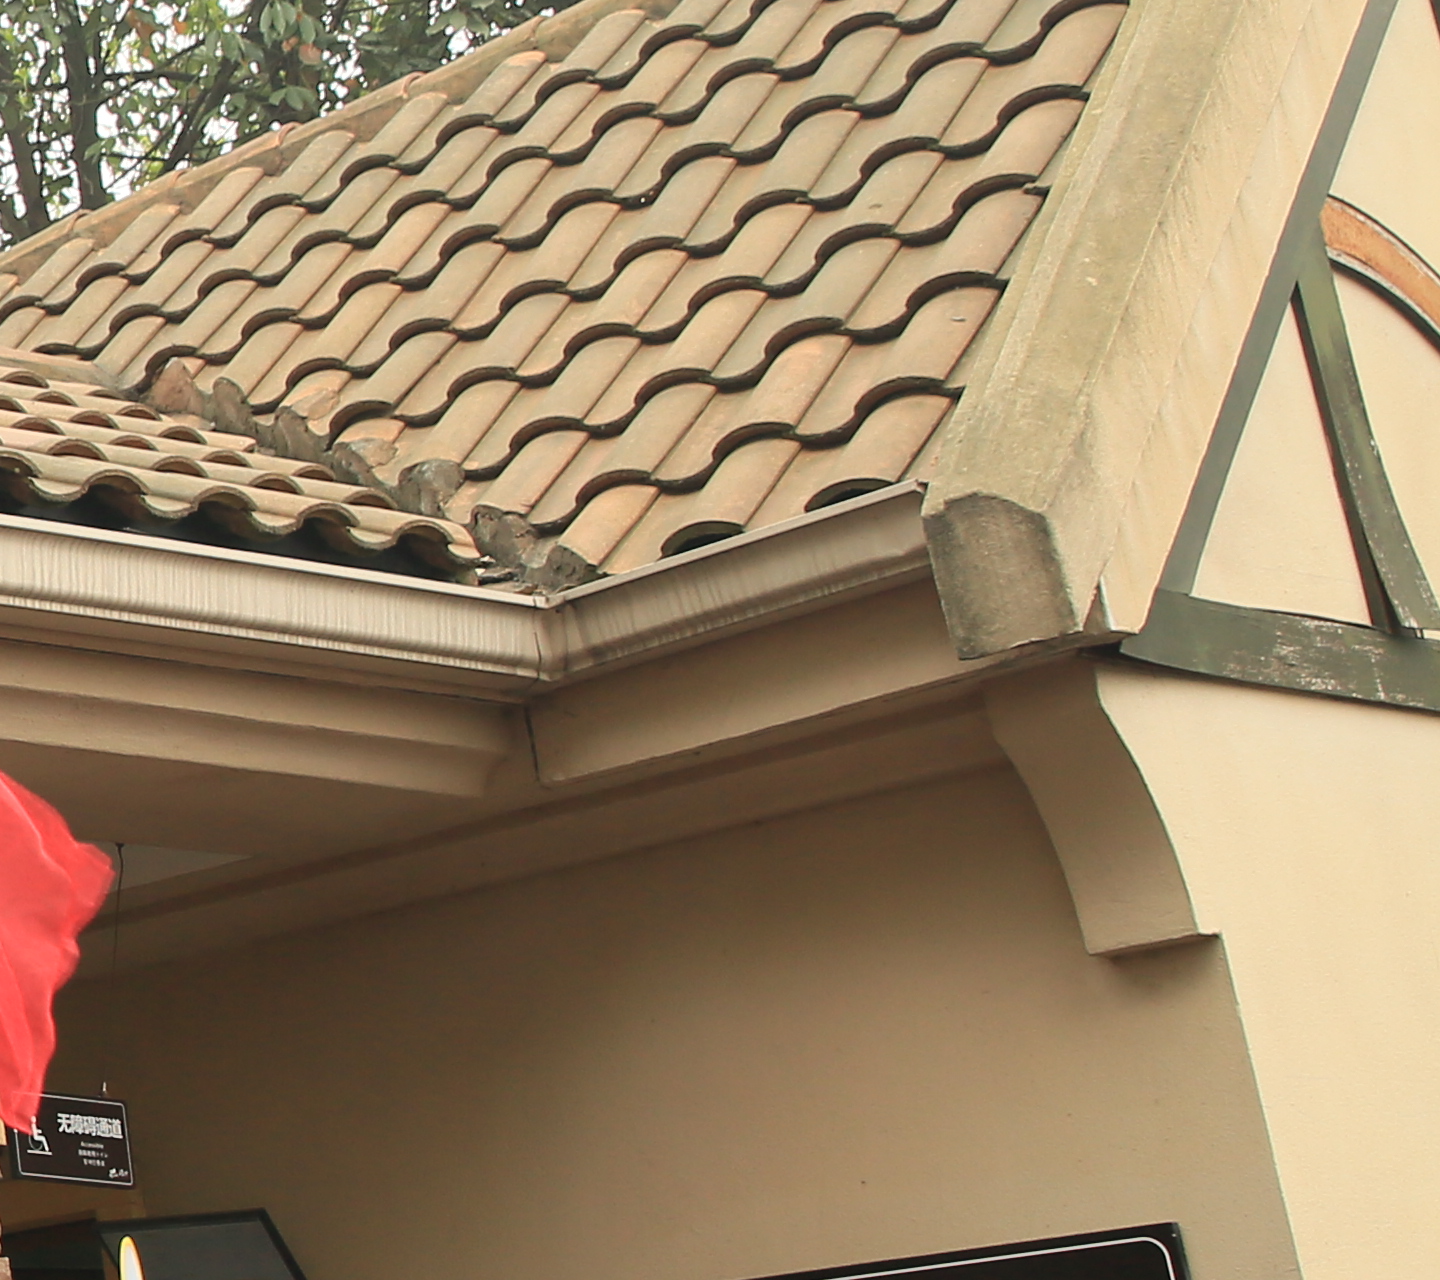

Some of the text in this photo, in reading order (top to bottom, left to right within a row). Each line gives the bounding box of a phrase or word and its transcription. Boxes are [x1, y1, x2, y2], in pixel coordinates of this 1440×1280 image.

[57, 1113, 124, 1139] 无障碍通道
